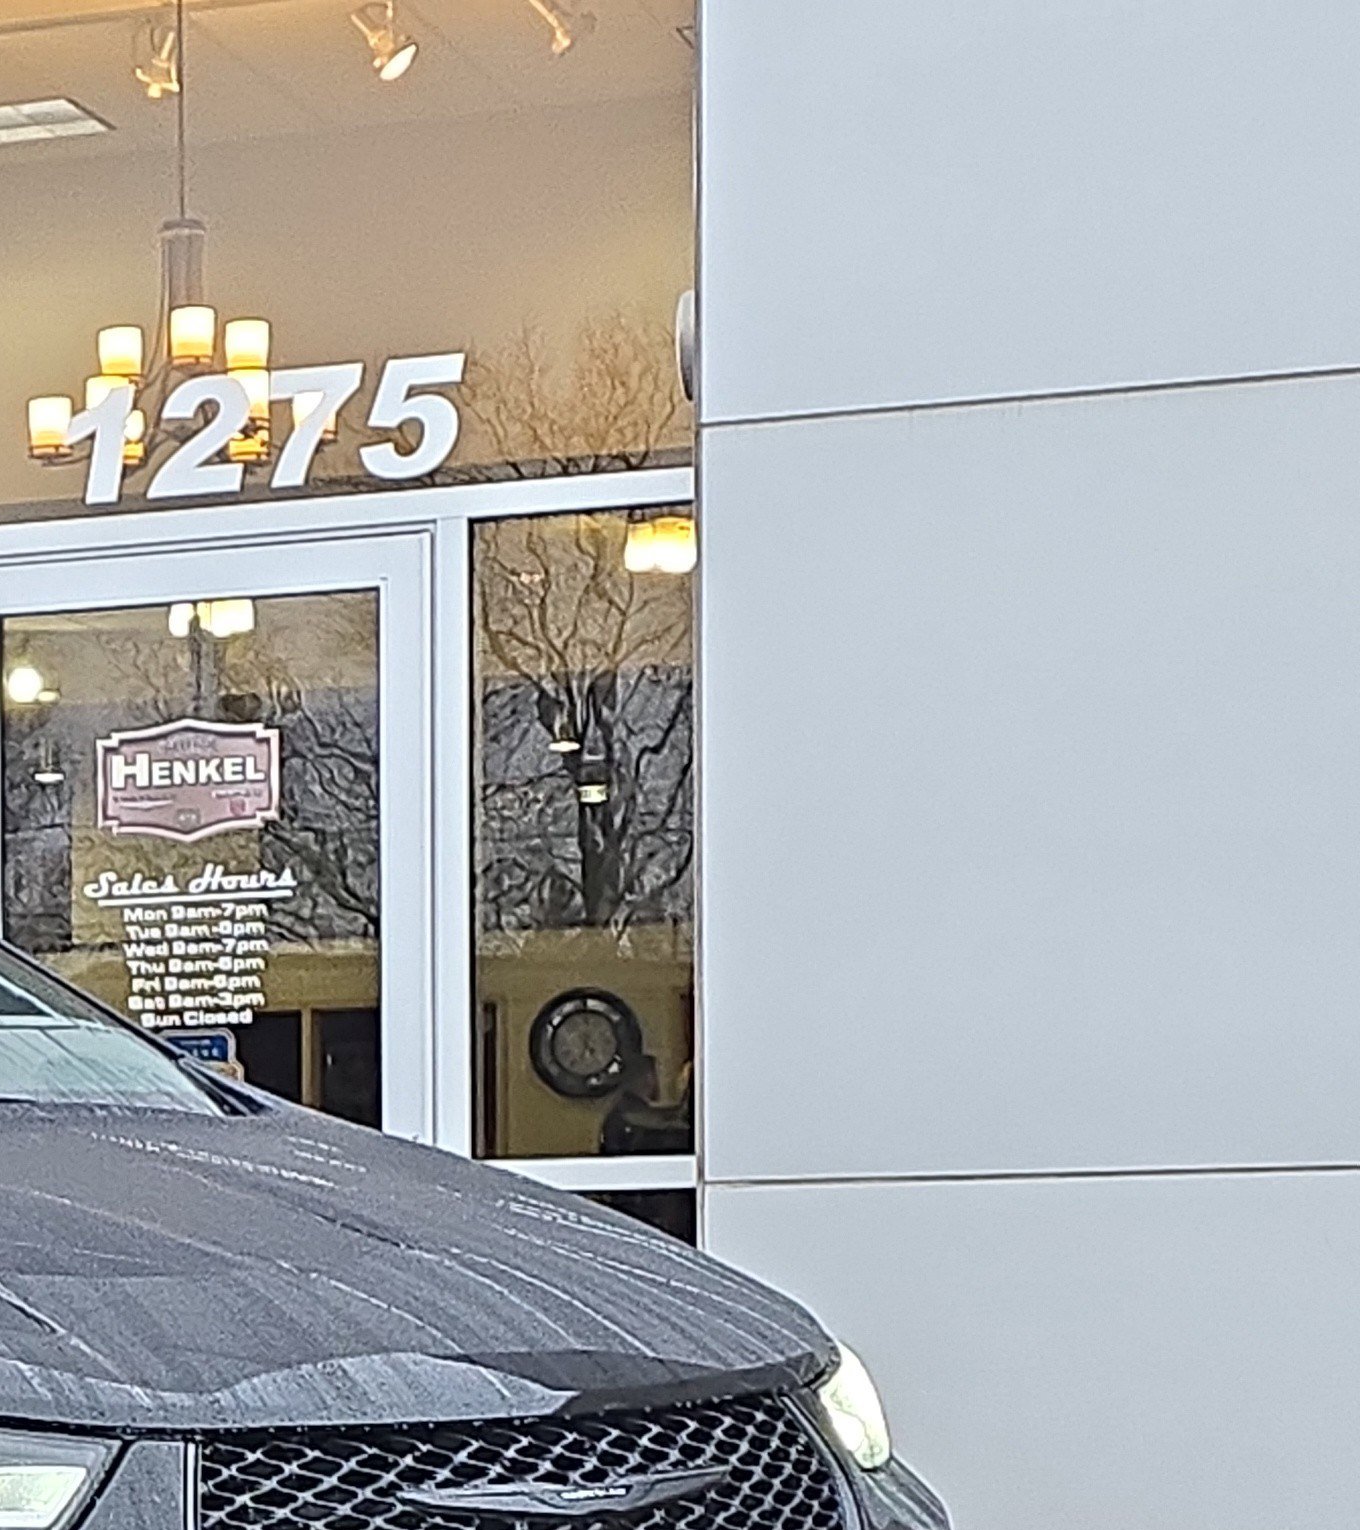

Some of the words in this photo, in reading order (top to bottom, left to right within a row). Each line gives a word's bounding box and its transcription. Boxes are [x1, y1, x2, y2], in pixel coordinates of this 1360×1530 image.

[66, 353, 465, 506] 1275
[111, 753, 266, 788] HENKEL
[83, 871, 180, 898] Sales
[188, 863, 298, 893] Hours
[123, 908, 168, 922] Mon
[125, 926, 162, 940] Tue
[122, 942, 170, 957] Wed
[126, 960, 166, 975] Thu
[131, 977, 162, 993] Fri
[127, 995, 166, 1010] Sat
[140, 1012, 181, 1028] Sun
[182, 1008, 253, 1026] Closed
